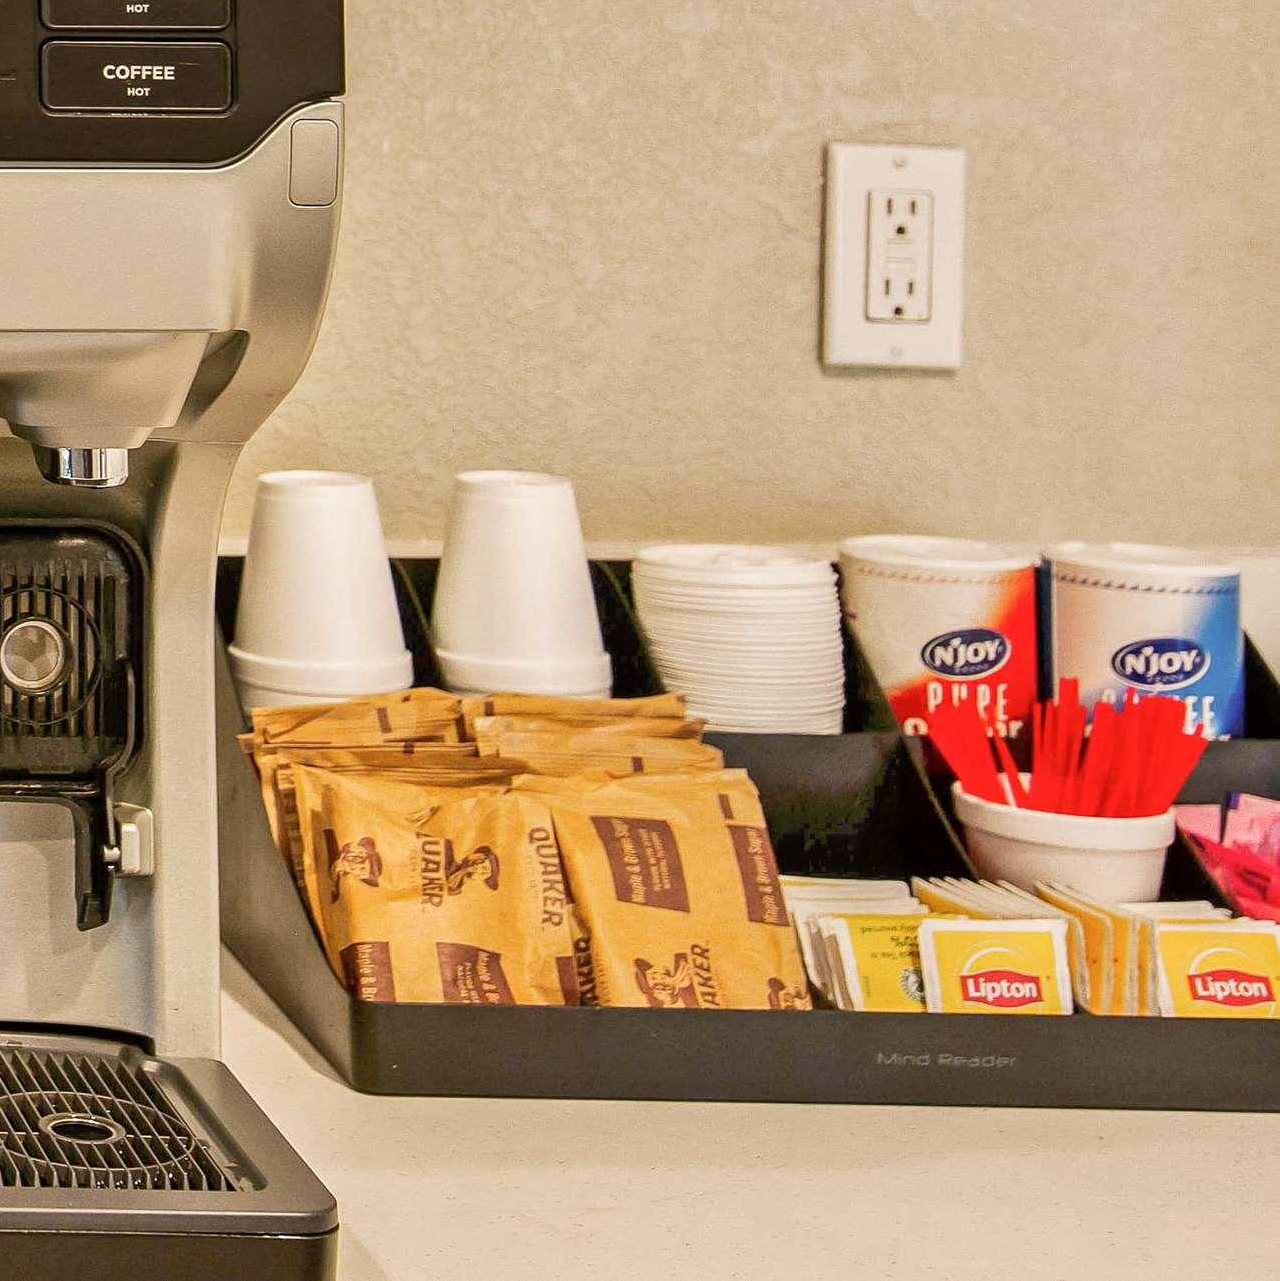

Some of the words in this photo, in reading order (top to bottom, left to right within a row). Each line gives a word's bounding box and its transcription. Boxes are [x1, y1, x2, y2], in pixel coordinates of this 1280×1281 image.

[126, 4, 150, 13] HOT
[102, 65, 176, 80] COFFEE
[127, 87, 151, 97] HOT
[415, 830, 443, 909] UAKER
[527, 826, 566, 928] QUAKER
[356, 944, 375, 977] Maple
[691, 943, 720, 1006] AKER
[967, 976, 1039, 1003] Lipton
[1194, 975, 1269, 1001] Lipton
[876, 1052, 931, 1067] Mind
[937, 1052, 1018, 1069] Reader
